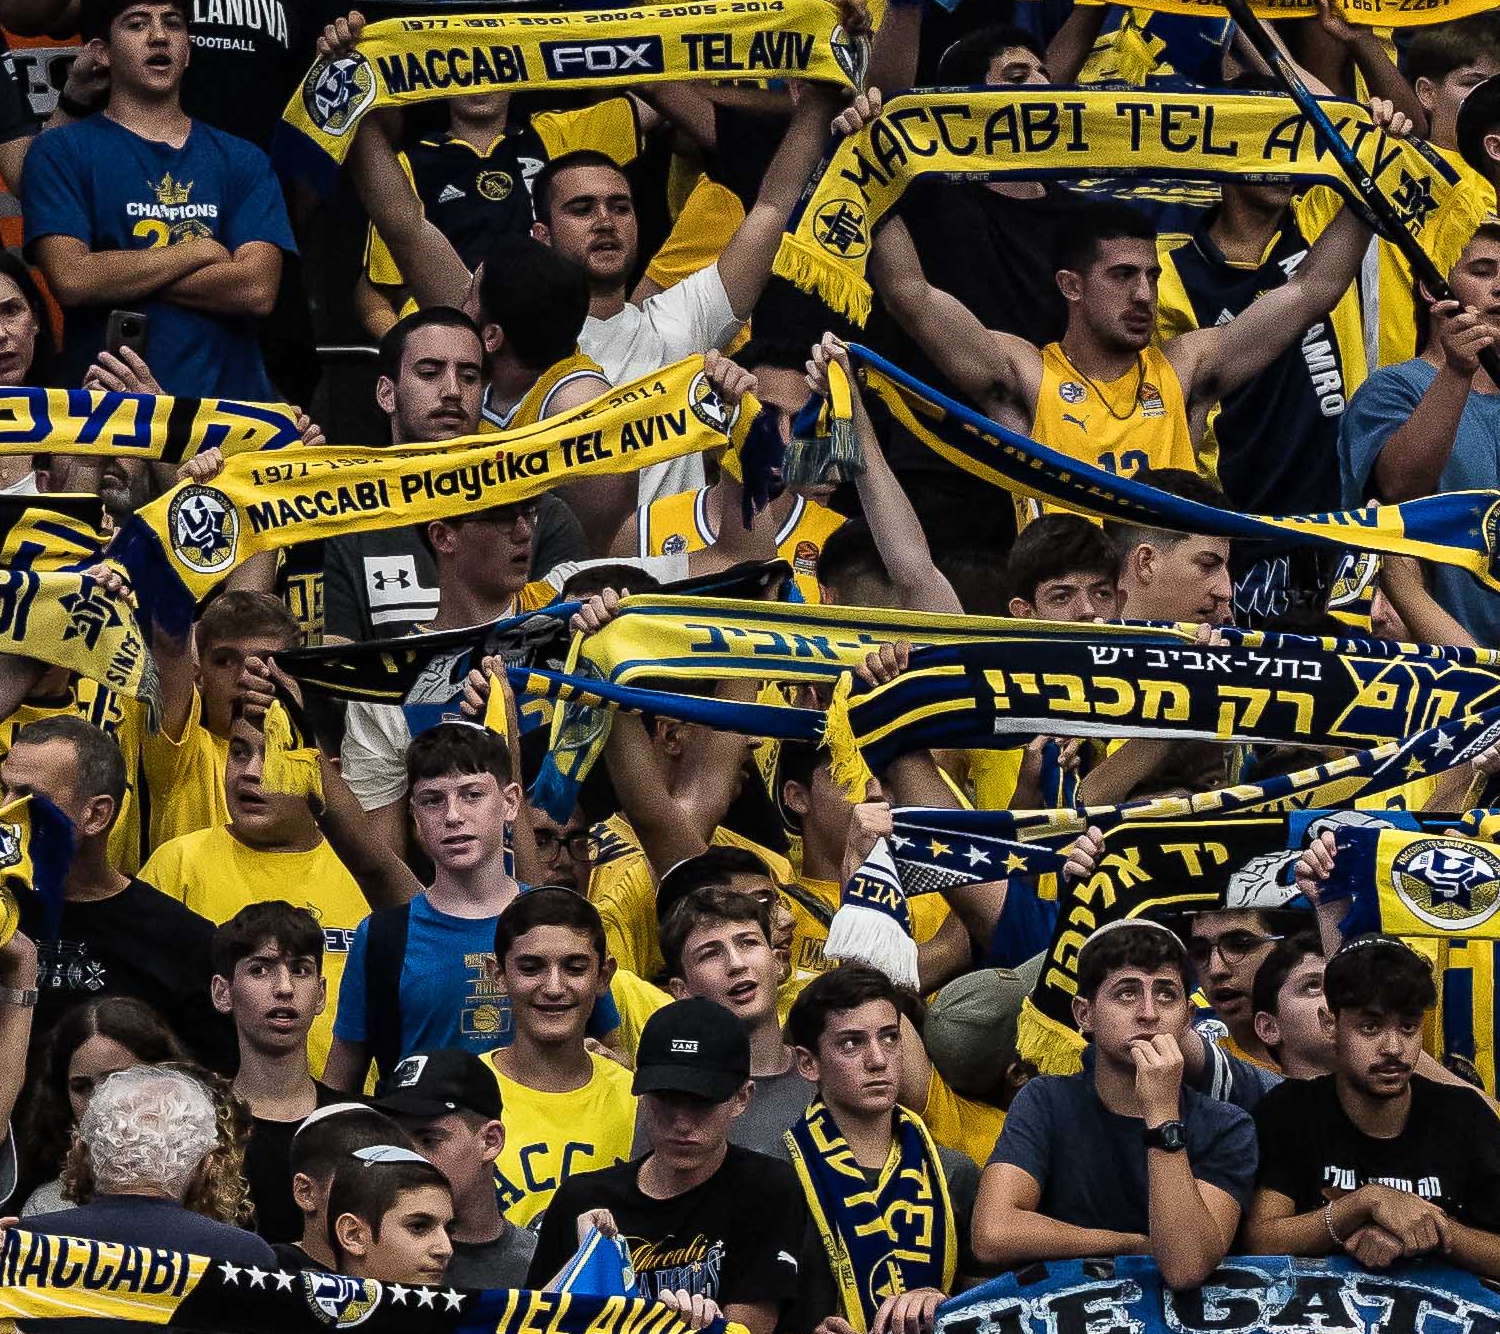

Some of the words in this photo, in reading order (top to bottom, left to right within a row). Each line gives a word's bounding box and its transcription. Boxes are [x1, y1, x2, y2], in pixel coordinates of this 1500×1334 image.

[377, 44, 528, 95] MACCABI
[552, 41, 652, 74] FOX
[681, 32, 746, 71] TEL
[748, 31, 815, 71] AVIV
[841, 102, 1091, 204] MACCABI
[1115, 101, 1239, 158] TEL
[126, 202, 218, 220] CHAMPIONS
[246, 482, 389, 533] MACCABI
[401, 450, 549, 502] Playtika
[559, 434, 613, 466] TEL
[620, 408, 688, 453] AVIV
[1086, 644, 1135, 667] יש
[1144, 647, 1323, 681] בתל-אביב
[991, 668, 1187, 721] מכבי!
[1216, 685, 1316, 741] רק
[1158, 841, 1230, 876] יד
[850, 876, 902, 911] אביב
[671, 1041, 699, 1052] VANS
